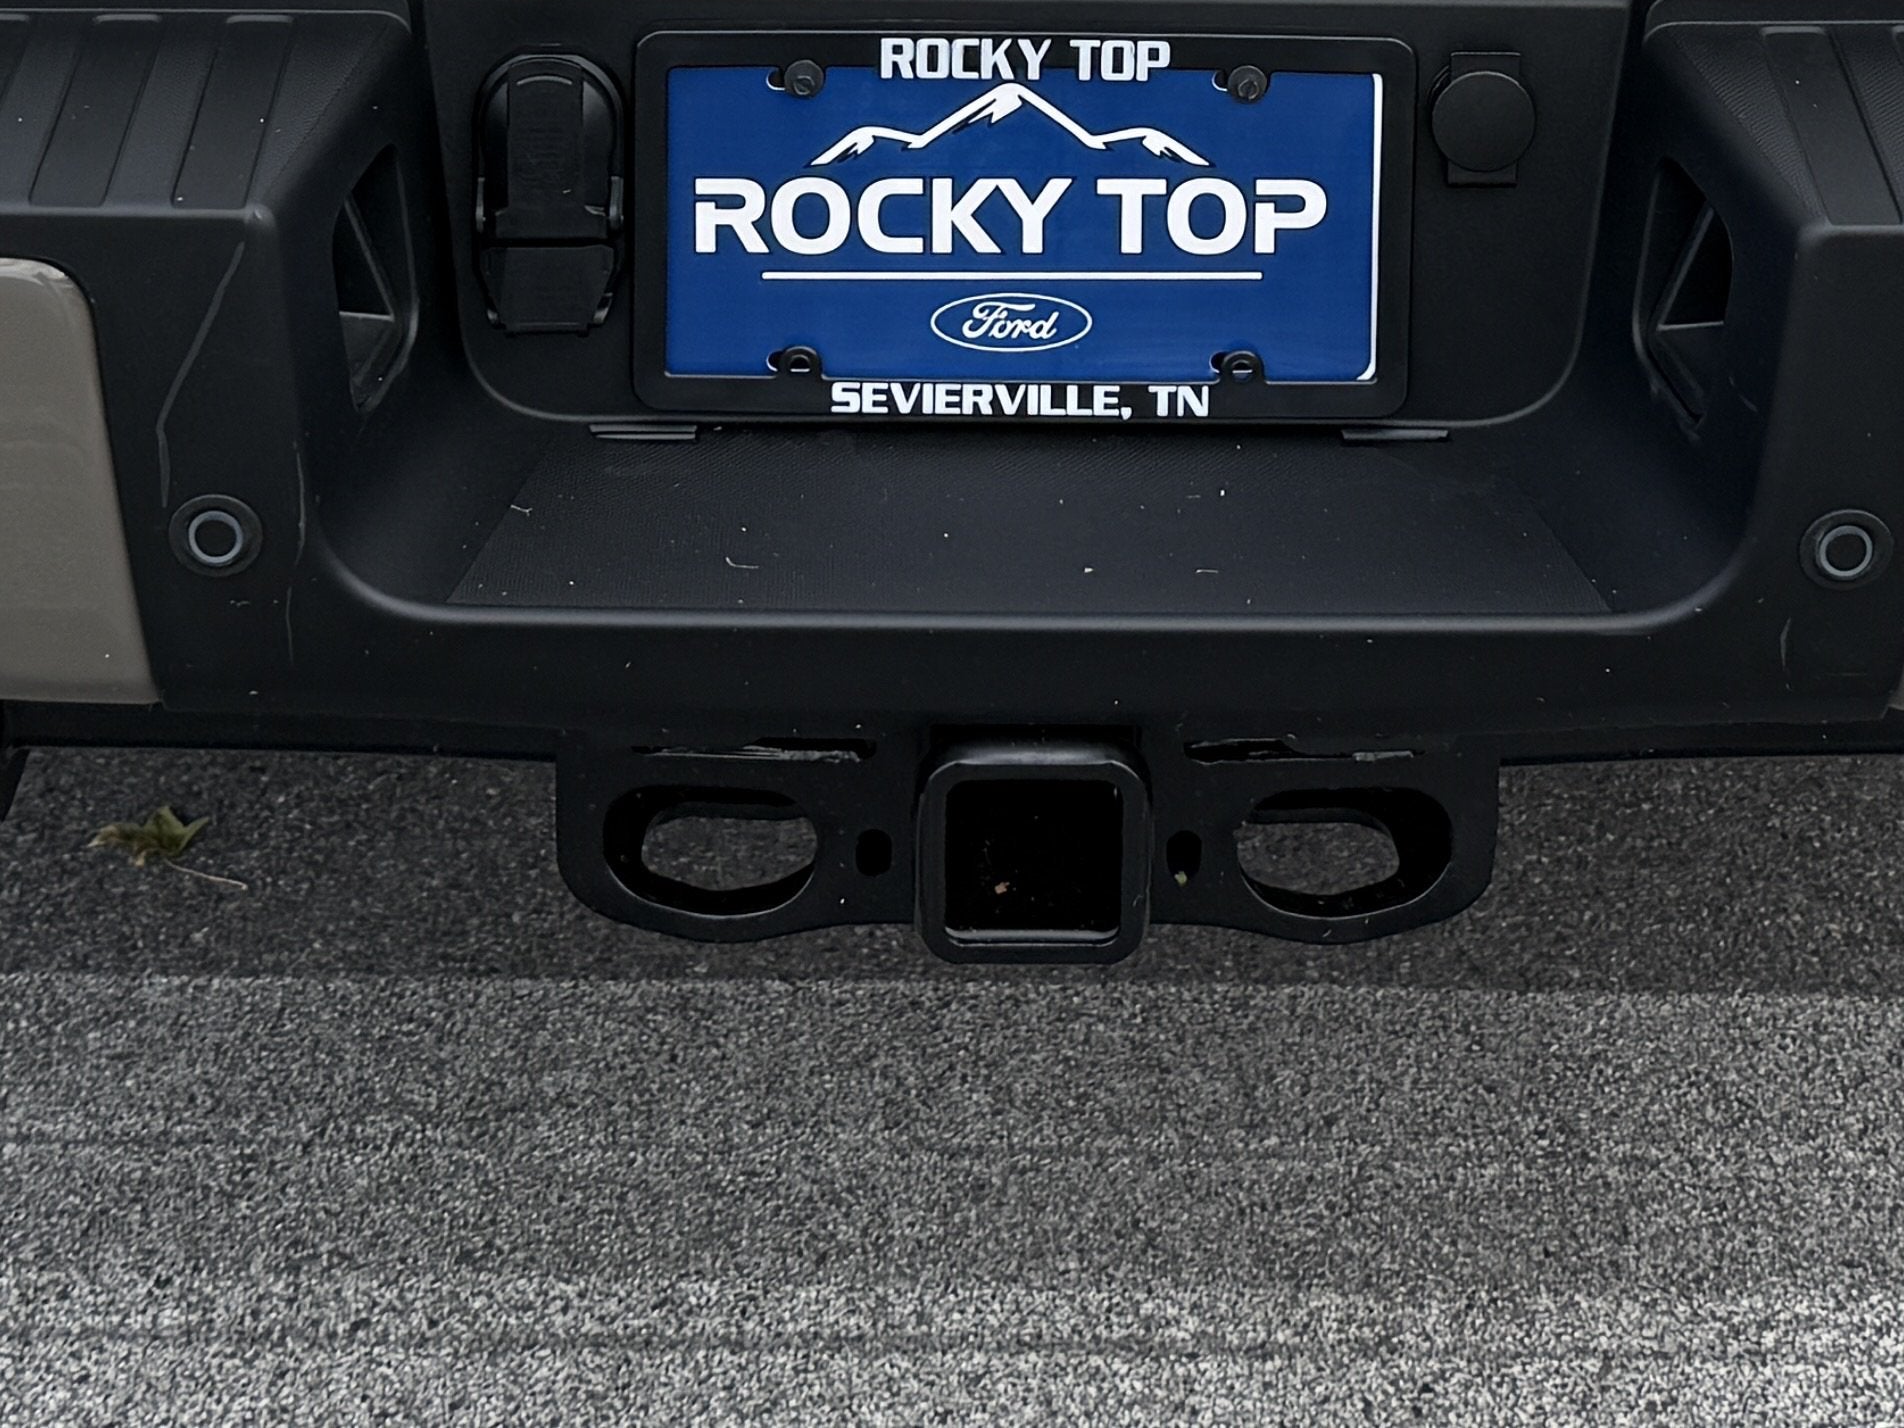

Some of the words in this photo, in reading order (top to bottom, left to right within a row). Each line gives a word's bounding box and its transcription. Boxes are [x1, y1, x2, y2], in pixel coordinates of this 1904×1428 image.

[879, 37, 1053, 82] ROCKY
[1069, 40, 1171, 83] TOP
[694, 177, 1075, 255] ROCKY
[1096, 178, 1328, 255] TOP
[962, 301, 1059, 339] Ford
[830, 382, 1132, 420] SEVIERVILLE,
[1148, 385, 1209, 418] TN
